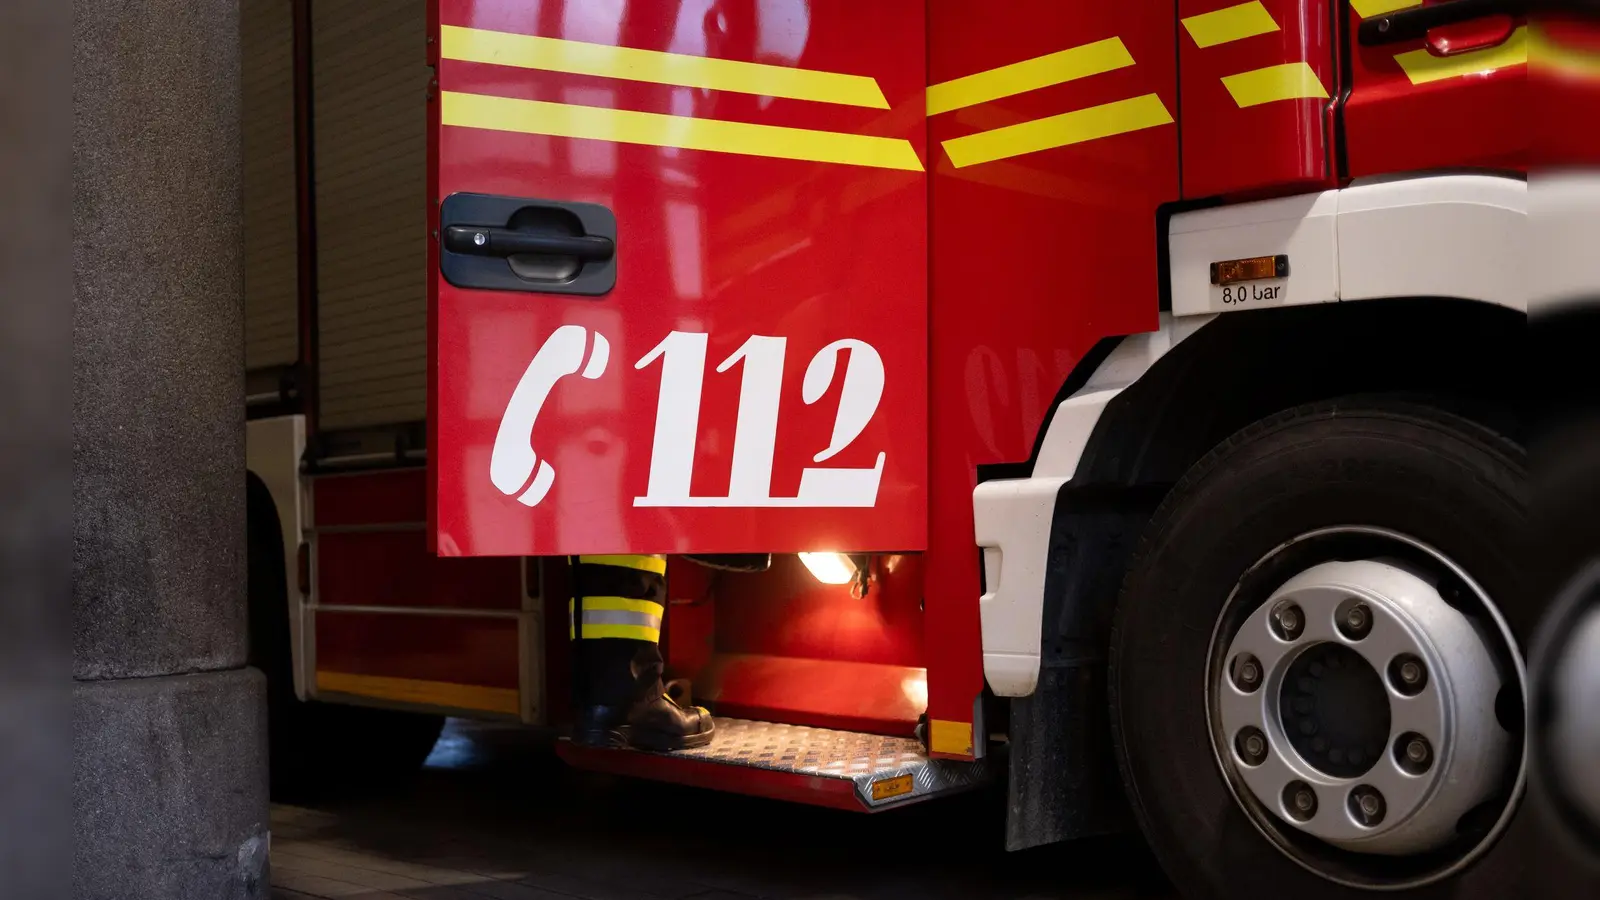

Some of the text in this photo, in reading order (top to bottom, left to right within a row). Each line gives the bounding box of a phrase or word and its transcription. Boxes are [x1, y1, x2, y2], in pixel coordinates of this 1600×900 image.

[1222, 284, 1281, 305] 8,0 bar
[633, 330, 886, 508] 112
